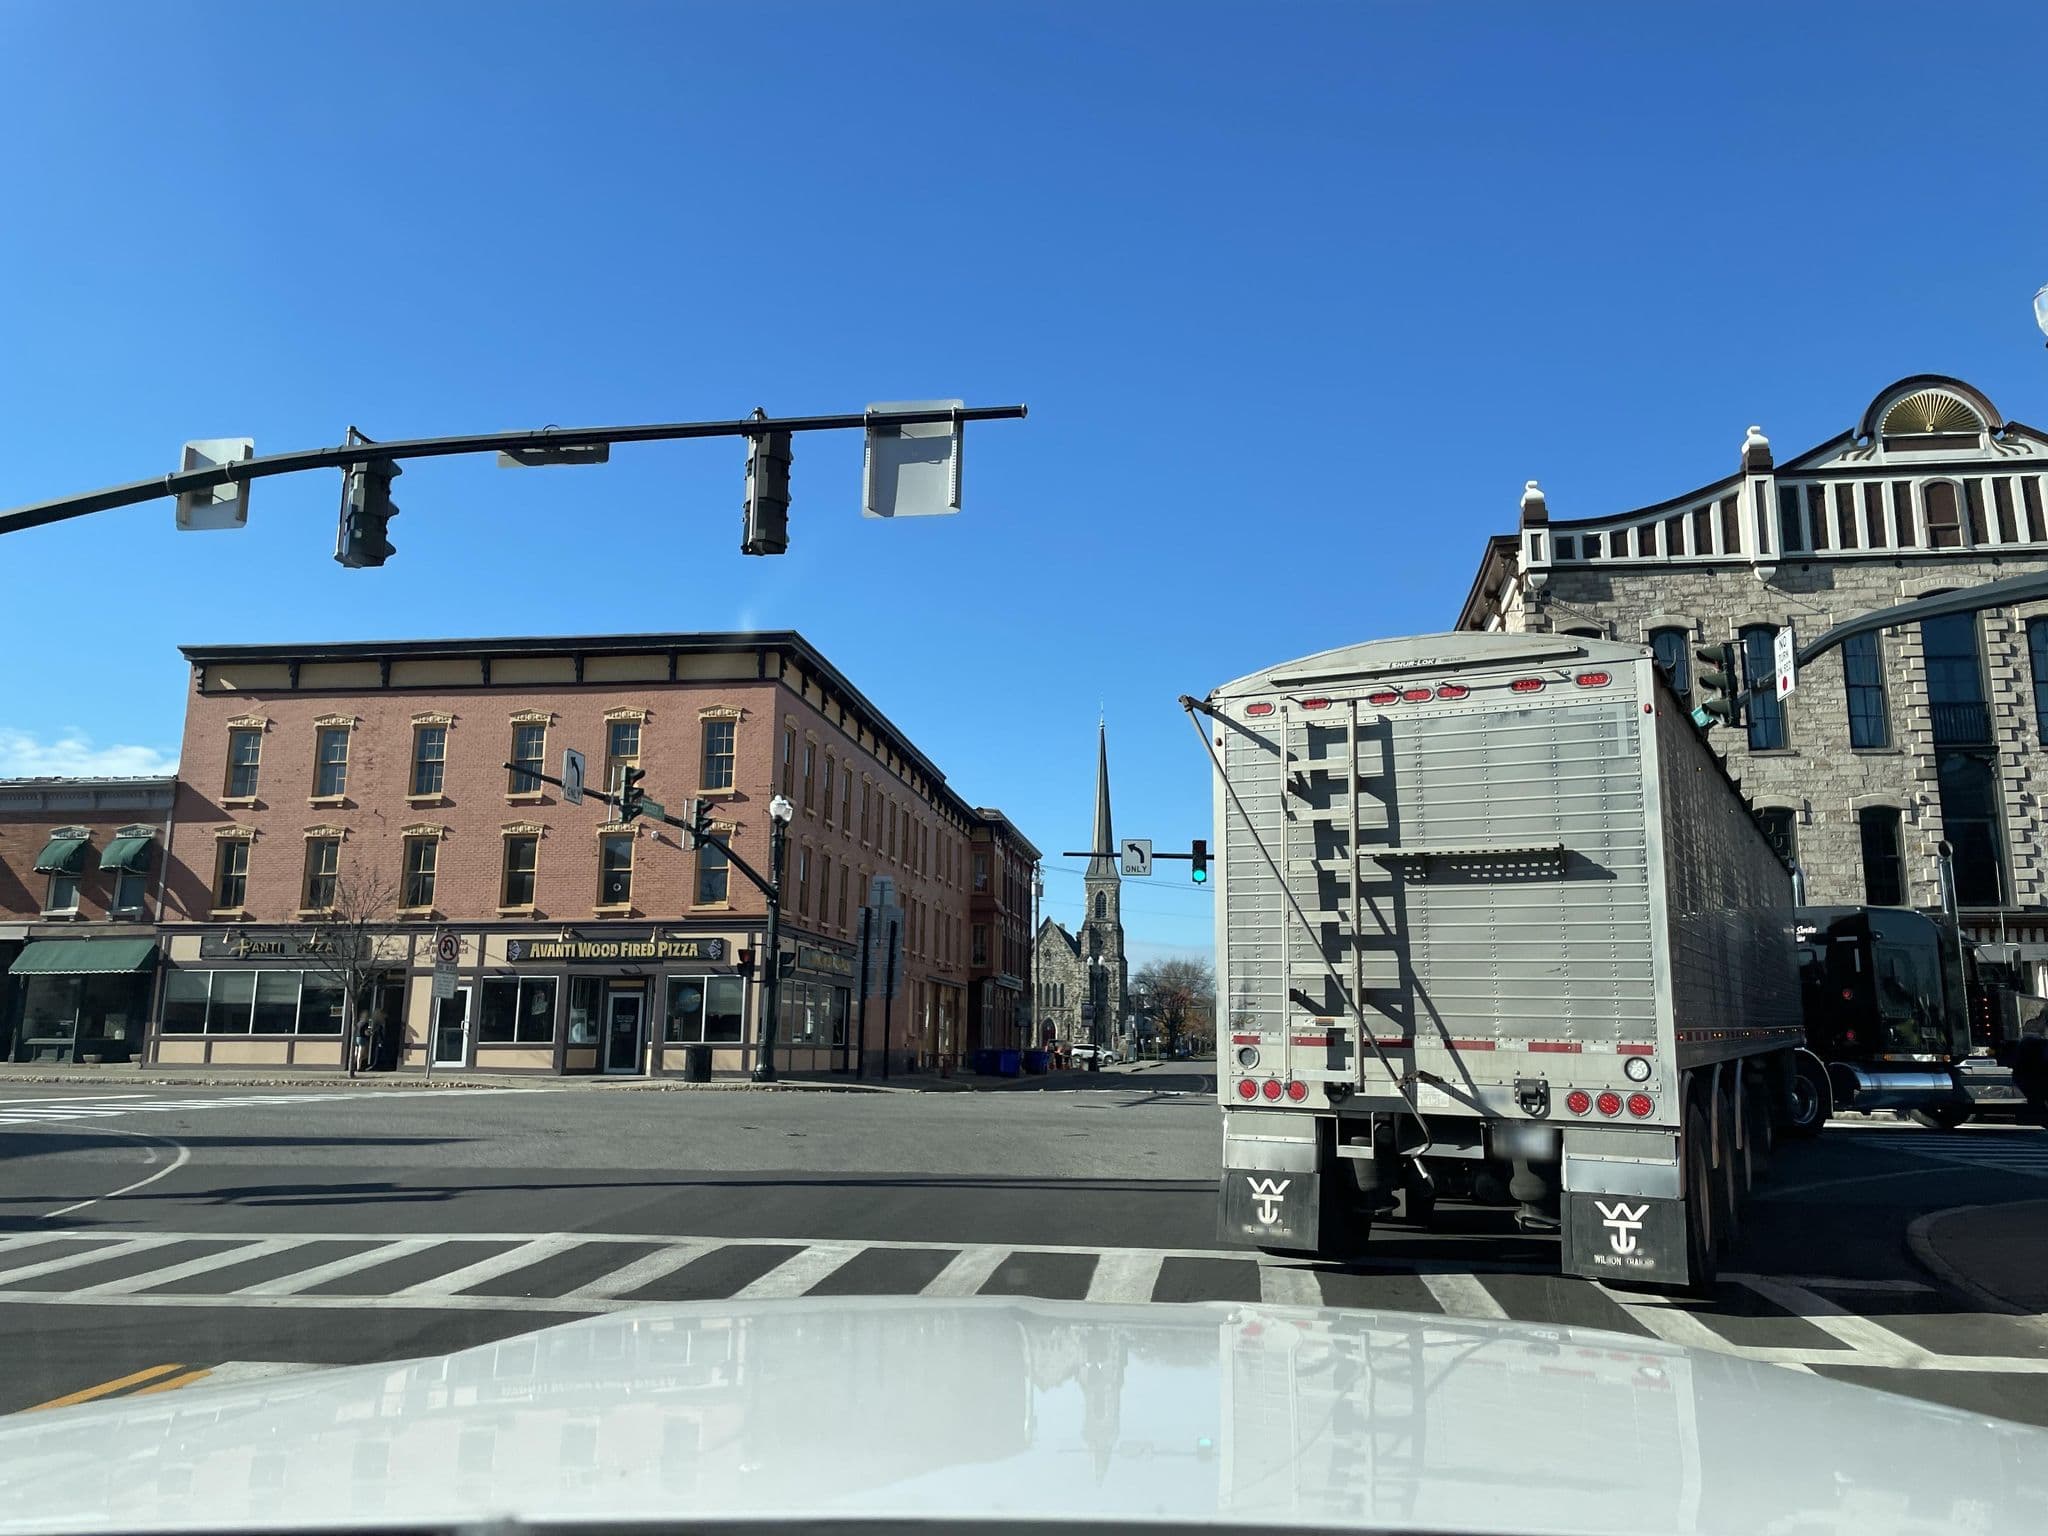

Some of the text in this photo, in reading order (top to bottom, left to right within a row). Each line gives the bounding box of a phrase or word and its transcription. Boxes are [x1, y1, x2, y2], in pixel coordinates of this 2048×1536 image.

[1778, 636, 1787, 649] NO
[1125, 865, 1147, 873] ONLY
[529, 941, 698, 958] AVANTI WOOD FIRED PIZZA
